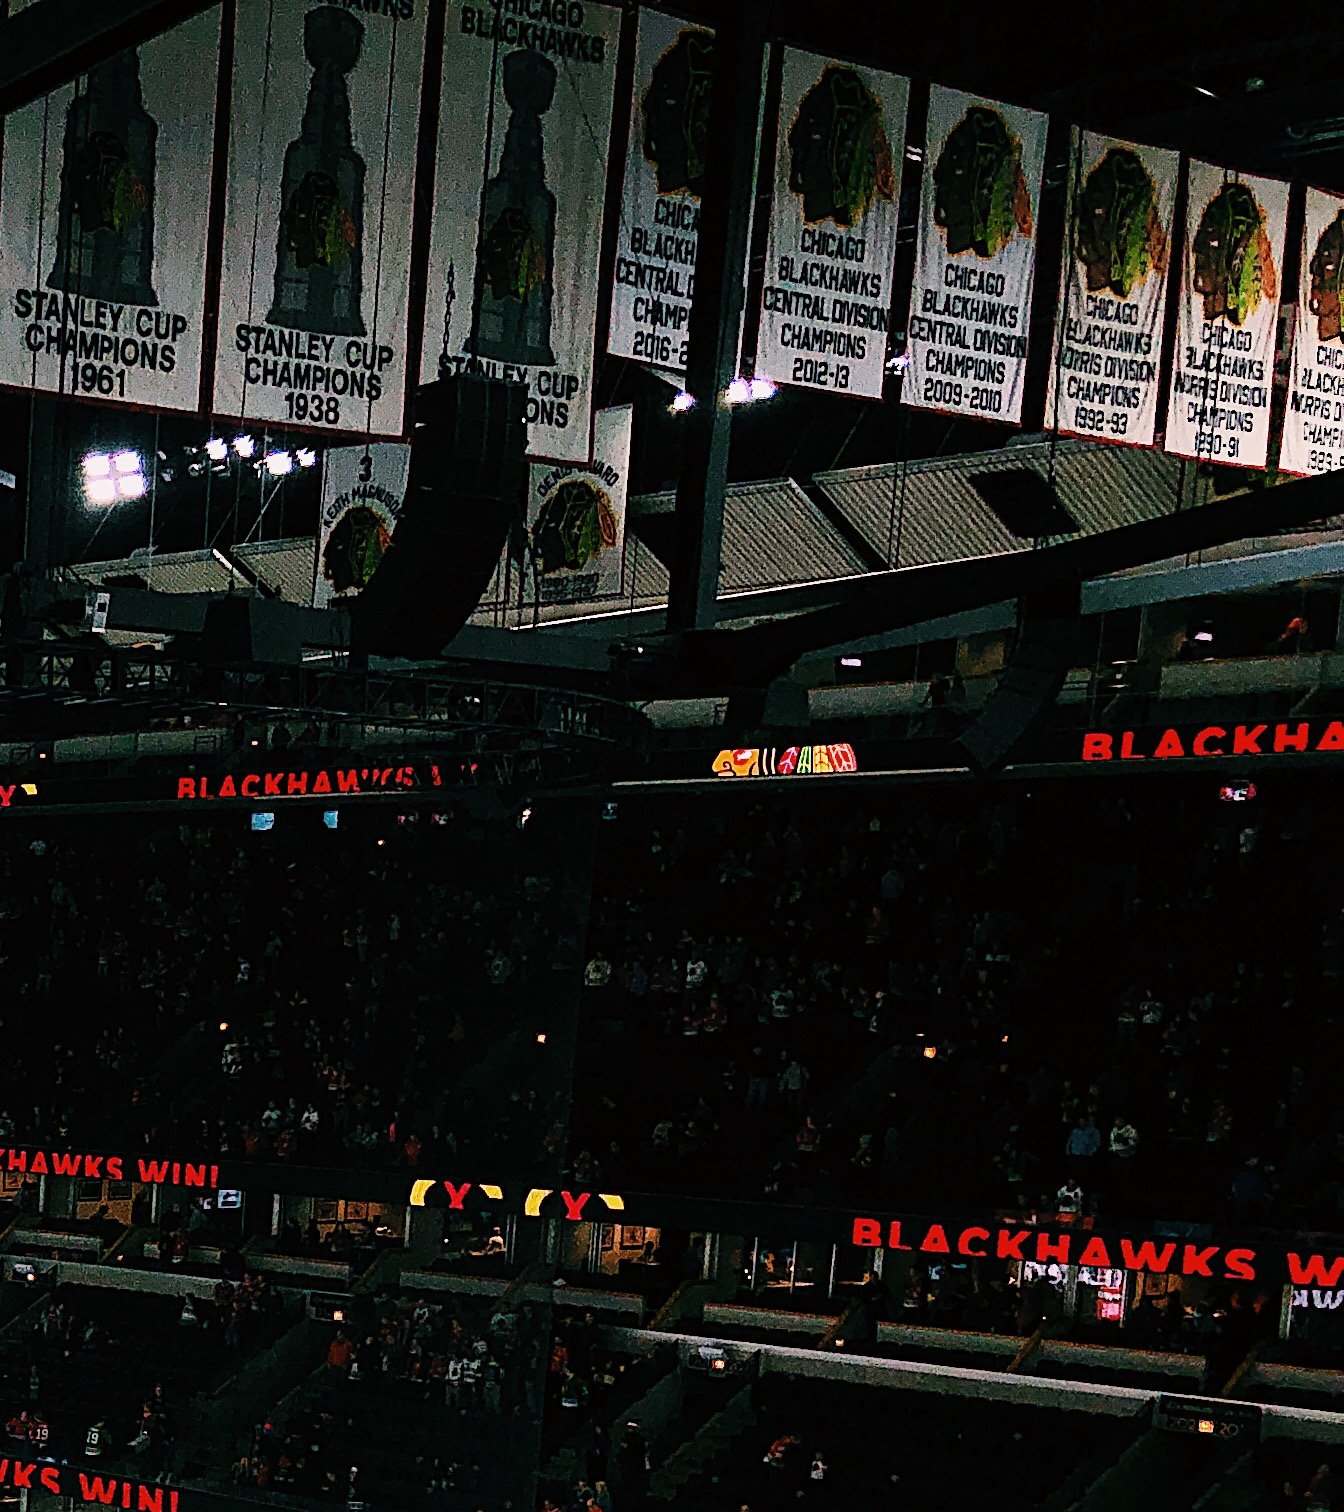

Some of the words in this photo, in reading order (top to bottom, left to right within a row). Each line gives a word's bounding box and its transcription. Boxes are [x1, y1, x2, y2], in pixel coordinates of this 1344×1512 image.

[801, 229, 865, 262] CHICAGO
[617, 261, 684, 296] CENTRAL
[779, 257, 881, 298] BLACKHAWKS
[945, 264, 1005, 296] CHICAGO
[15, 288, 124, 334] STANLEY
[136, 309, 187, 343] CUP
[764, 286, 825, 323] CENTRAL
[832, 295, 889, 332] DIVISION
[922, 289, 1018, 328] BLACKHAWKS
[1086, 295, 1138, 325] CHICAGO
[25, 323, 177, 373] CHAMPIONS
[235, 324, 336, 364] STANLEY
[346, 340, 394, 372] CUP
[782, 324, 866, 359] CHAMPIONS
[909, 315, 970, 349] CENTRAL
[974, 327, 1027, 357] DIVISION
[1066, 318, 1152, 355] BLACKHAWKS
[1202, 323, 1252, 352] CHICAGO
[71, 363, 126, 398] 1961
[244, 358, 381, 402] CHAMPIONS
[793, 359, 849, 388] 2012-13
[926, 349, 1005, 384] CHAMPIONS
[538, 371, 579, 400] CUP
[924, 379, 1001, 412] 2009-2010
[1068, 376, 1140, 408] CHAMPIONS
[285, 393, 340, 425] 1938
[358, 455, 373, 481] 3
[139, 1159, 219, 1188] WIN!
[852, 1216, 1257, 1281] BLACKHAWKS
[88, 1431, 99, 1444] 19
